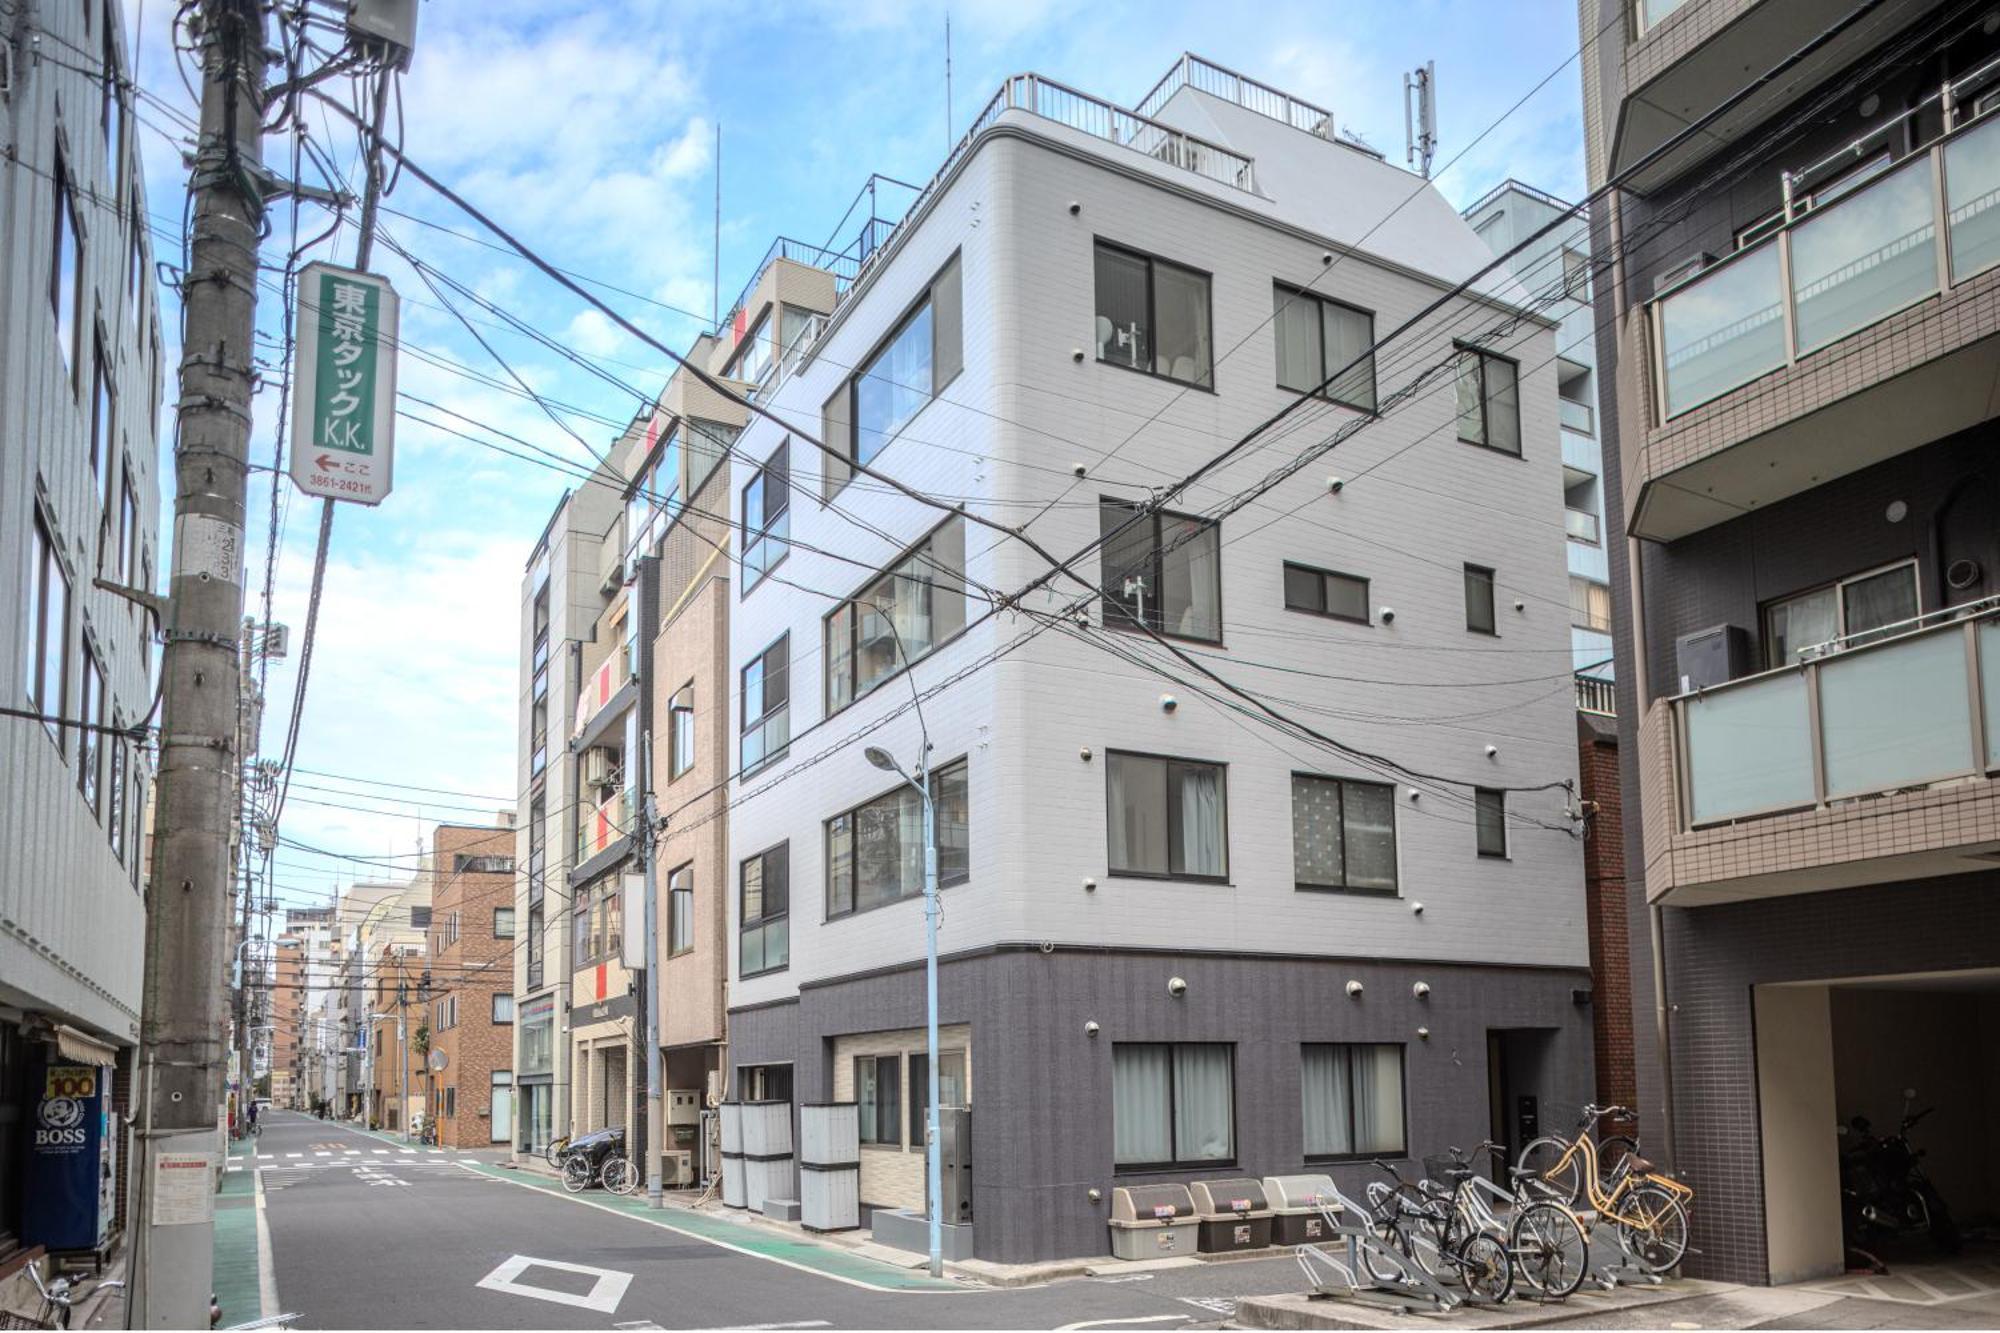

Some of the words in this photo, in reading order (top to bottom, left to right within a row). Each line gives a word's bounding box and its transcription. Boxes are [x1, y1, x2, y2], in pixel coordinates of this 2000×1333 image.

[331, 283, 366, 417] 東京タック
[344, 462, 371, 476] ここ
[34, 1128, 86, 1145] BOSS
